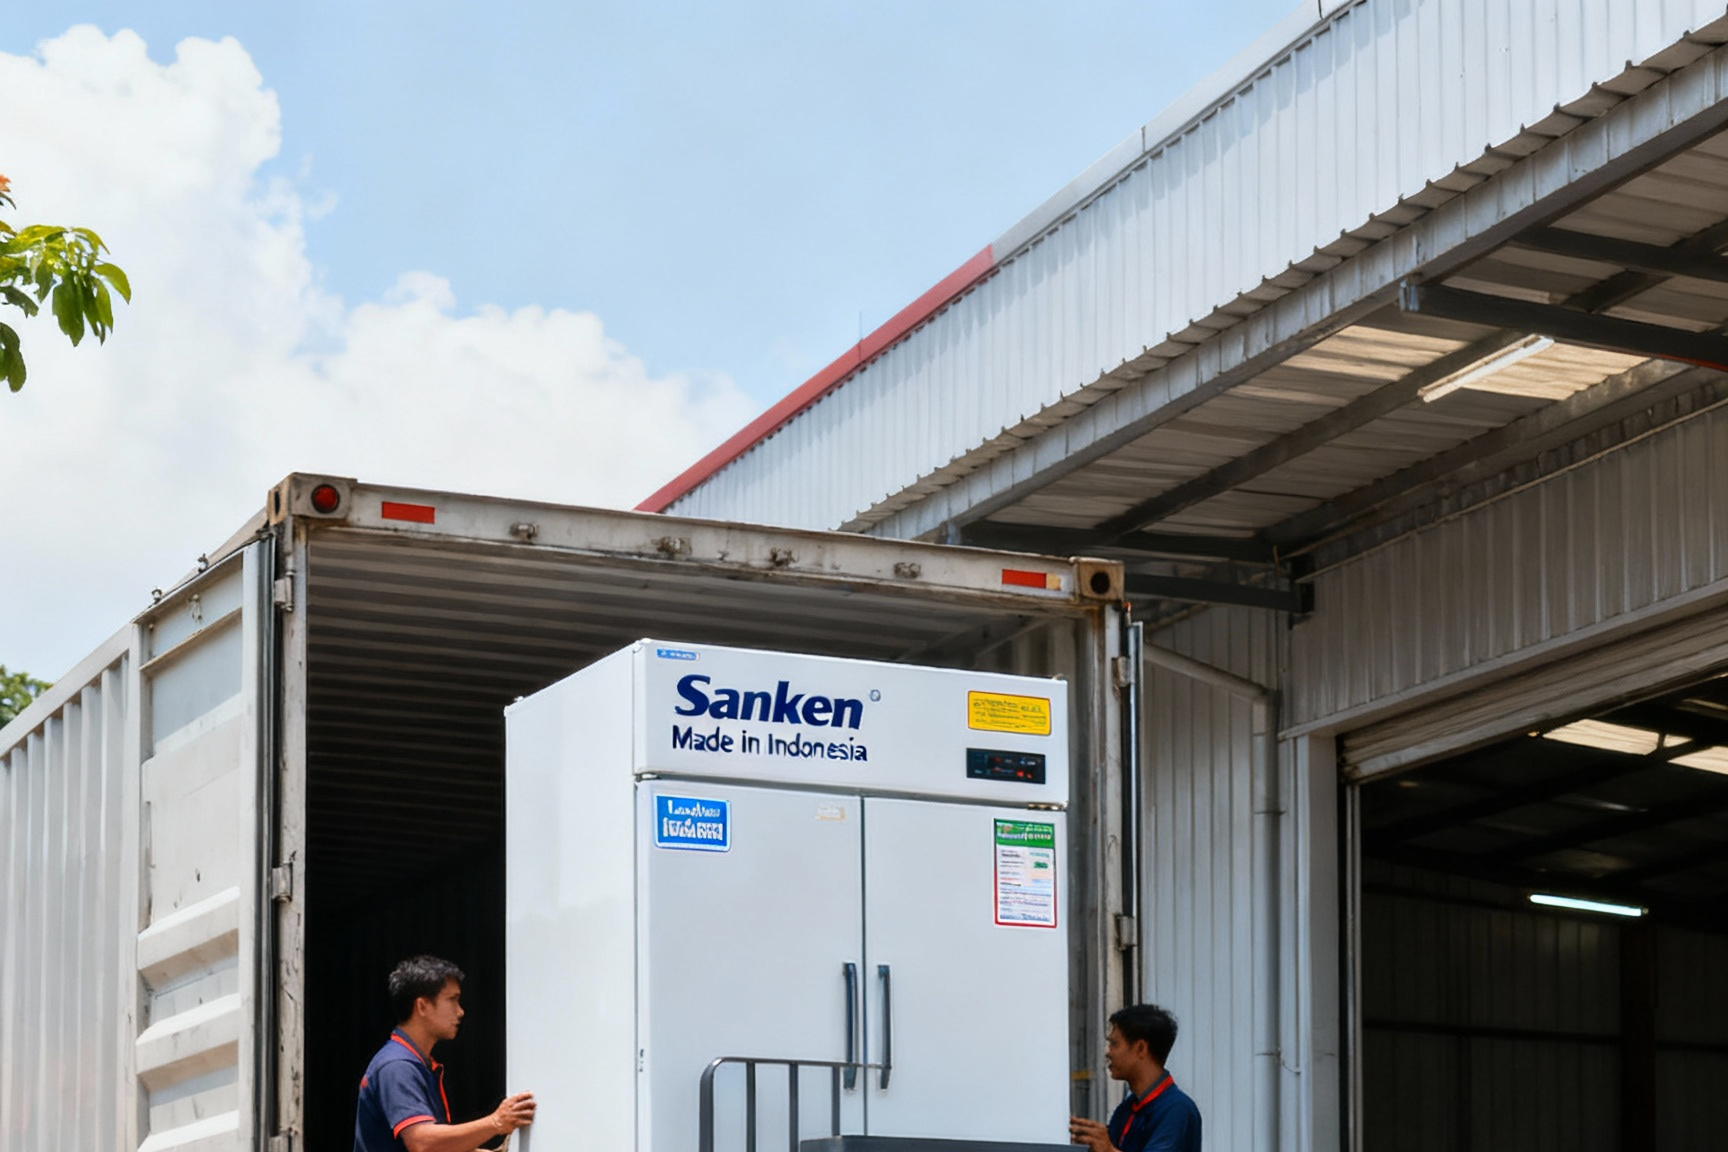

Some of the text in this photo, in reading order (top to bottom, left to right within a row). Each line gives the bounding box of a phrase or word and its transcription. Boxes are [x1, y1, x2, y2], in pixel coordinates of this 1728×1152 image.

[675, 674, 863, 729] Sanken
[672, 725, 867, 761] Made in Indonesia
